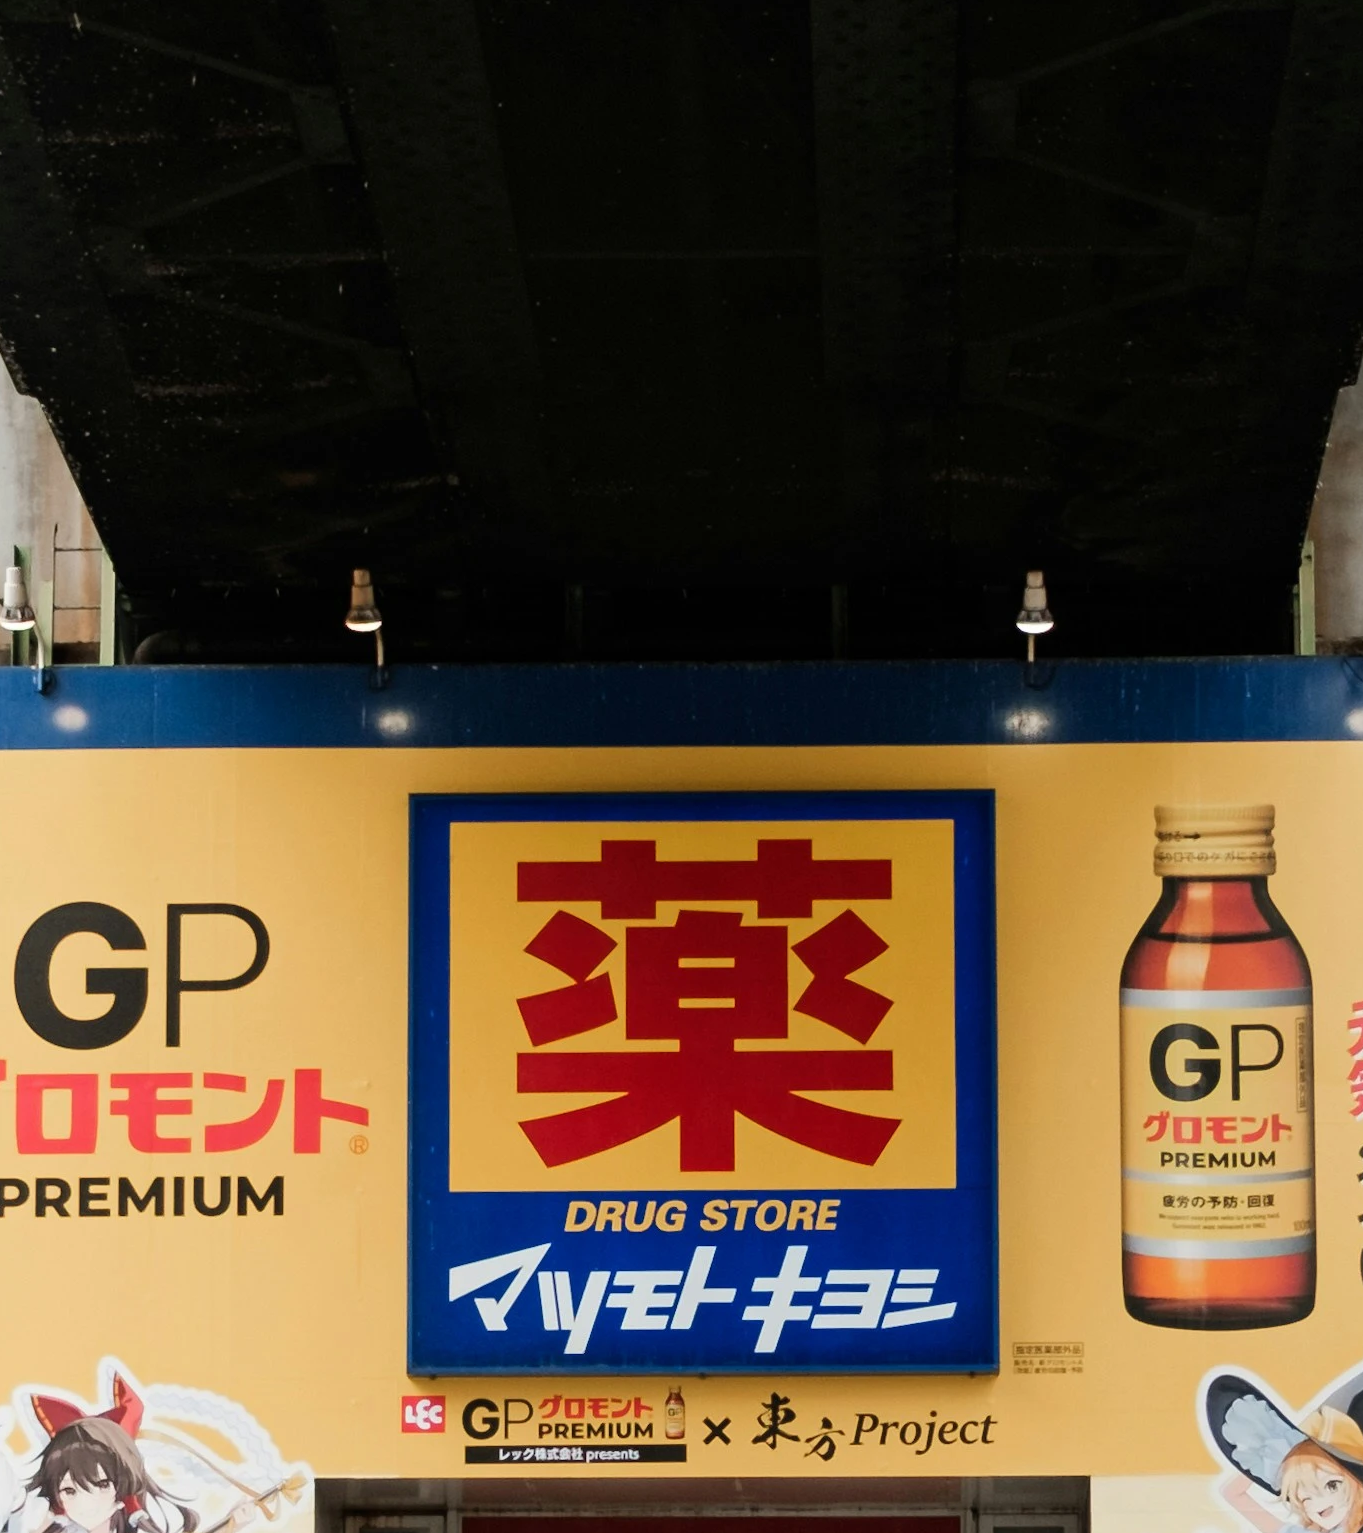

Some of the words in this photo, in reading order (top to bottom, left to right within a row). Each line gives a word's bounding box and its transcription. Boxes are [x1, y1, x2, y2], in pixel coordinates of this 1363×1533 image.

[14, 901, 270, 1051] GP
[516, 838, 903, 1173] 薬
[1149, 1023, 1284, 1102] GP
[1143, 1110, 1292, 1144] グロモント
[1160, 1150, 1276, 1168] PREMIUM
[564, 1198, 686, 1233] DRUG
[700, 1198, 840, 1232] STORE
[449, 1242, 958, 1355] マツモトキヨシ
[461, 1398, 534, 1440] GP
[538, 1394, 654, 1419] グロモント
[538, 1422, 654, 1439] PREMIUM
[850, 1412, 998, 1457] Project
[498, 1448, 584, 1462] レック株式会社
[586, 1449, 640, 1464] presents
